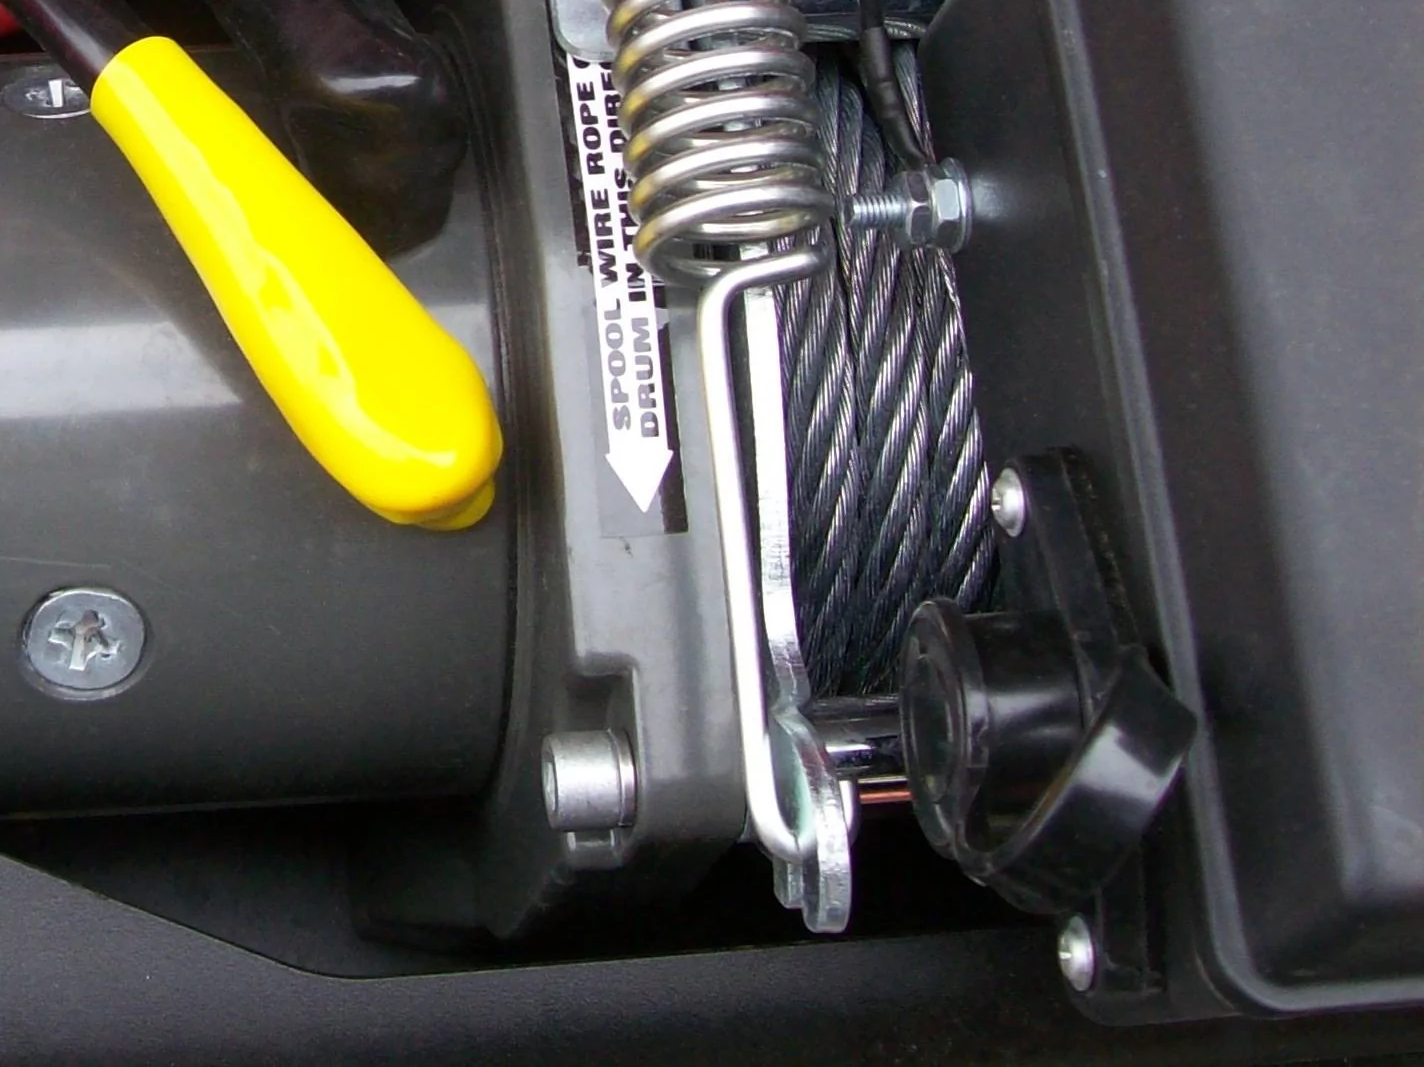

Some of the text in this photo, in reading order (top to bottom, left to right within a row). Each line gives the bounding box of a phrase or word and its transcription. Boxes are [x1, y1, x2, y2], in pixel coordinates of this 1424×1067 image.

[576, 81, 606, 176] ROPE
[590, 188, 619, 289] WIRE
[625, 262, 648, 302] IN
[603, 297, 632, 431] SPOOL
[631, 316, 660, 438] DRUM
